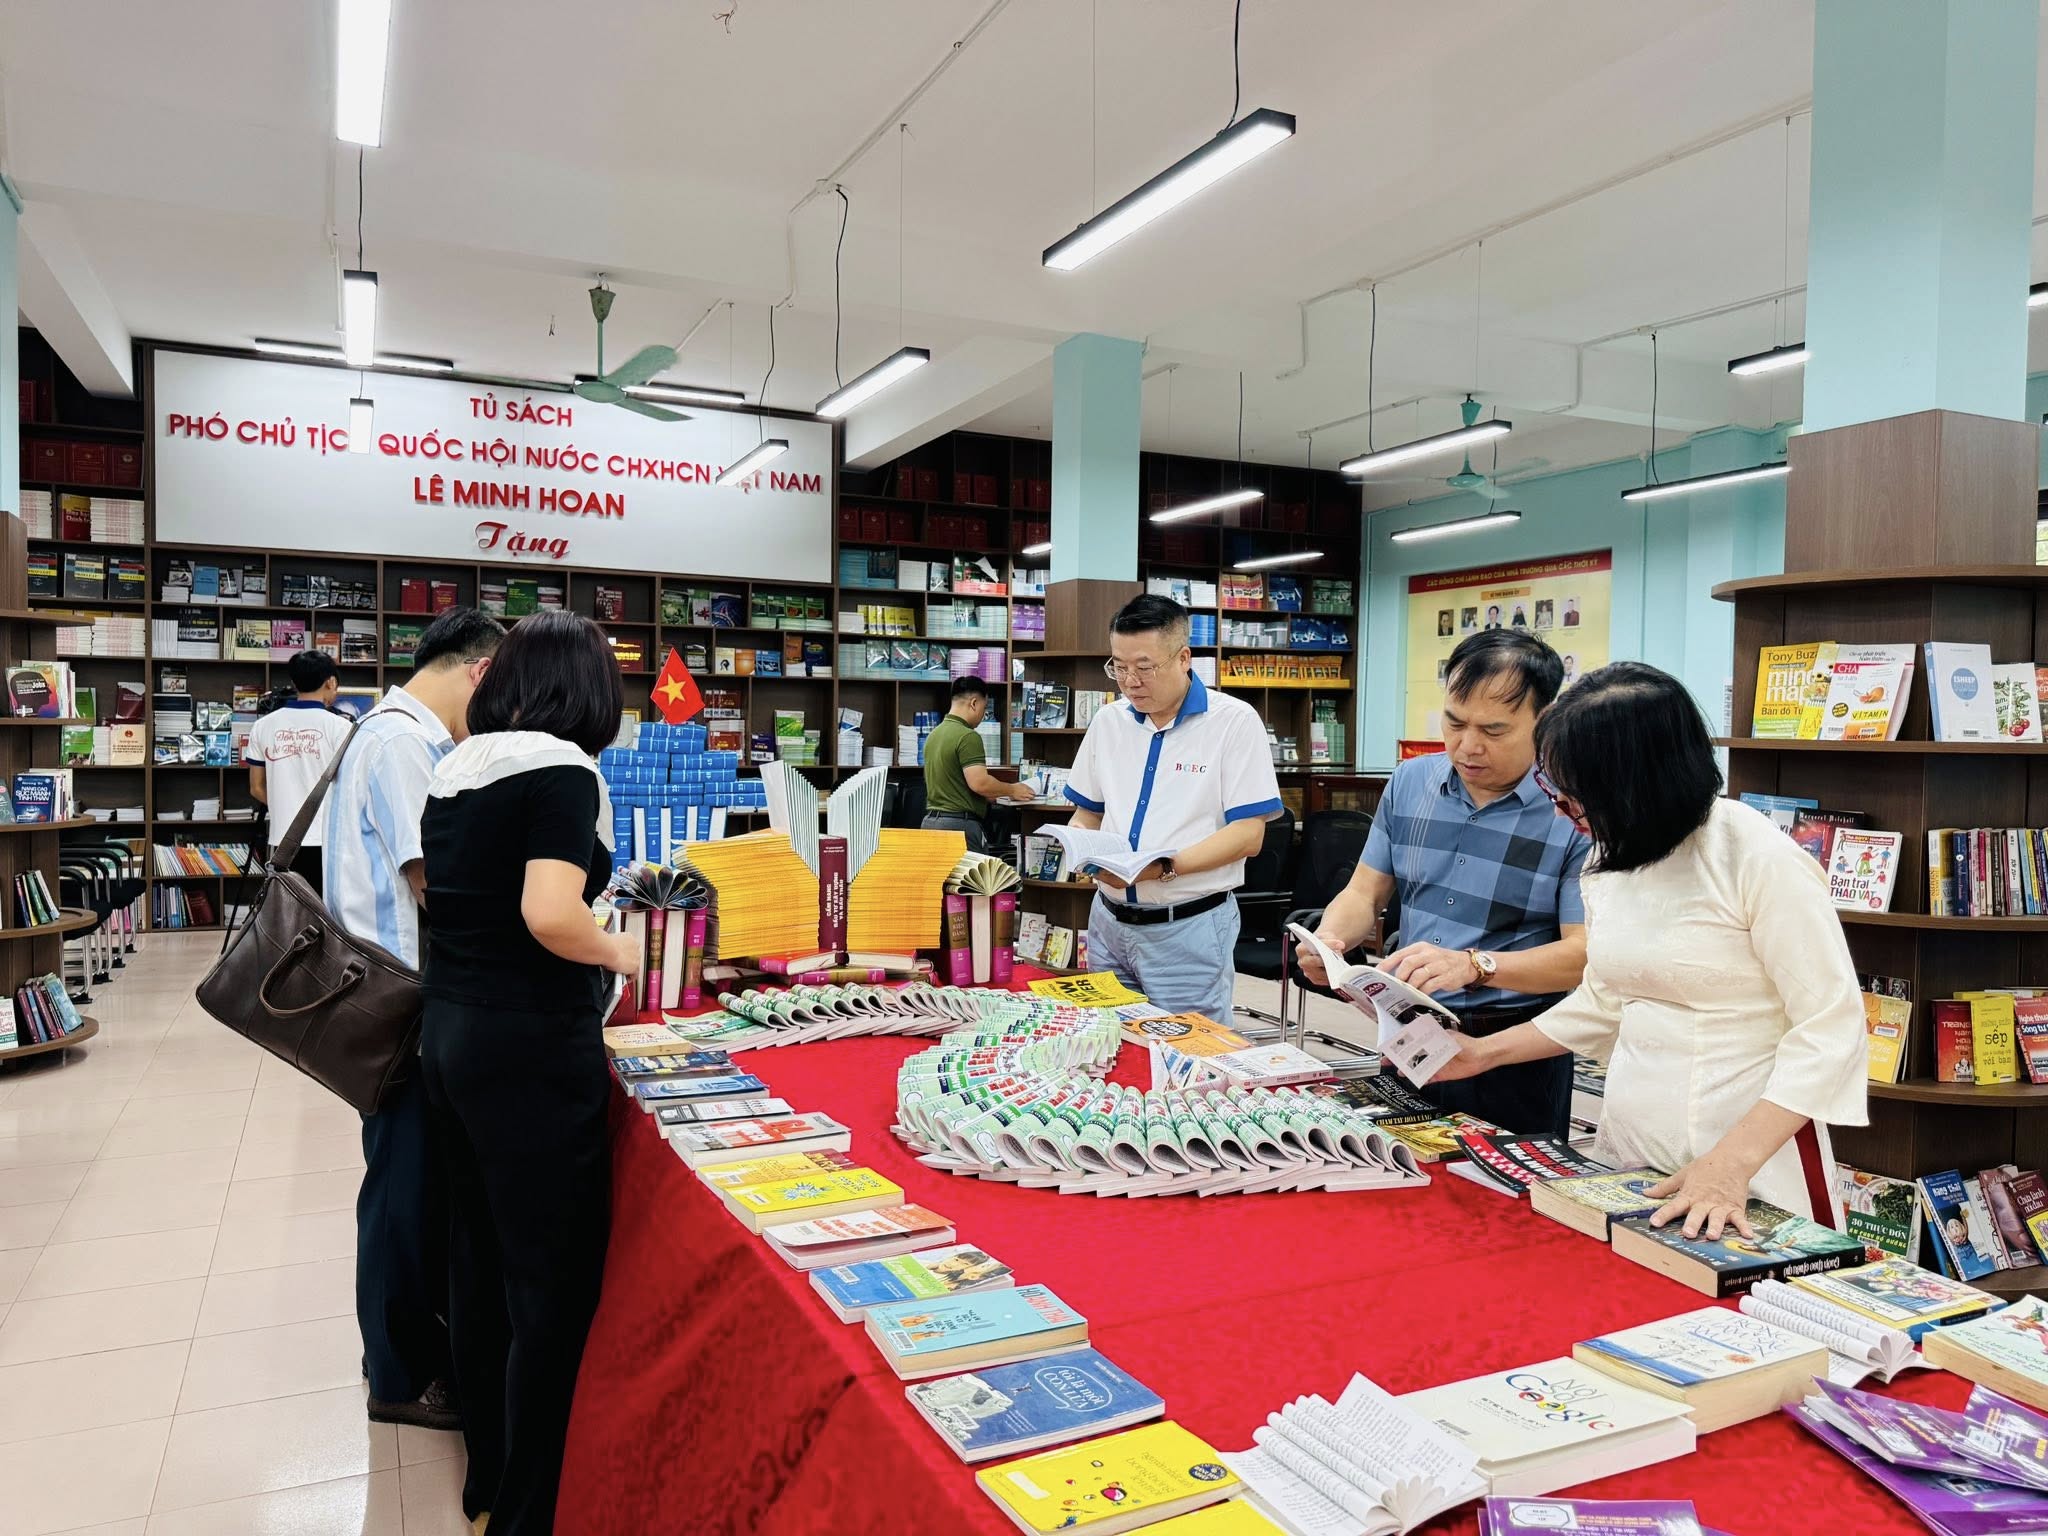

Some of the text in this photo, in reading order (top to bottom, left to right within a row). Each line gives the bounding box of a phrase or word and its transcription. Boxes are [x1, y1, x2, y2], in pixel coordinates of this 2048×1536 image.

[470, 392, 573, 427] TỦ SÁCH
[169, 411, 229, 440] PHÓ
[236, 417, 295, 447] CHỦ
[306, 423, 349, 456] TỊC
[378, 428, 464, 459] QUỐC
[472, 437, 517, 468] HỘI
[526, 444, 599, 473] NƯỚC
[607, 455, 710, 484] CHXHCN
[770, 471, 821, 492] NAM
[414, 473, 625, 517] LÊ MINH HOAN
[475, 521, 570, 560] Tặng
[1767, 651, 1793, 662] Tony
[1831, 875, 1850, 889] Bạn
[1984, 1025, 2008, 1047] sếp
[1851, 1217, 1863, 1227] 30
[1864, 1221, 1888, 1235] THỰC
[1043, 1372, 1068, 1392] CON
[1058, 1369, 1078, 1381] tôi
[1505, 1373, 1615, 1430] Google
